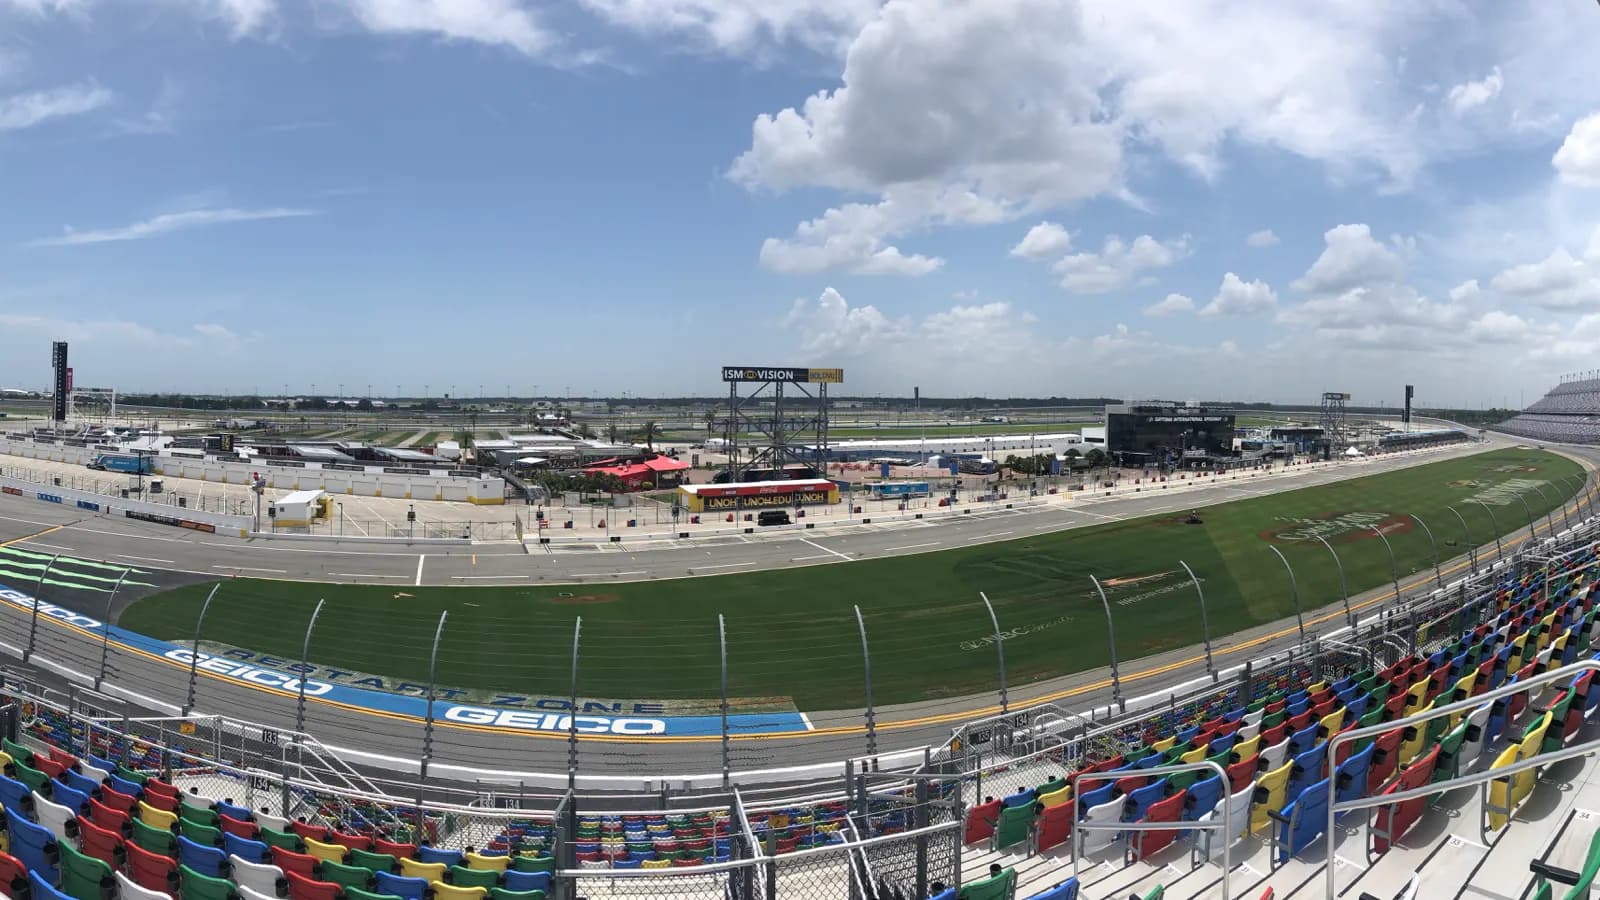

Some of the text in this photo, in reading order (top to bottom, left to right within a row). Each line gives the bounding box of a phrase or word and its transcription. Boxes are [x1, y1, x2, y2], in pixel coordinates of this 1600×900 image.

[724, 369, 794, 380] ISM VISION
[709, 498, 737, 508] UNOH
[0, 589, 102, 628] GEICO
[164, 649, 334, 696] GEICO
[222, 648, 664, 714] RESTART ZONE
[444, 705, 666, 736] GEICO
[263, 730, 277, 745] 133
[1451, 838, 1460, 846] 33
